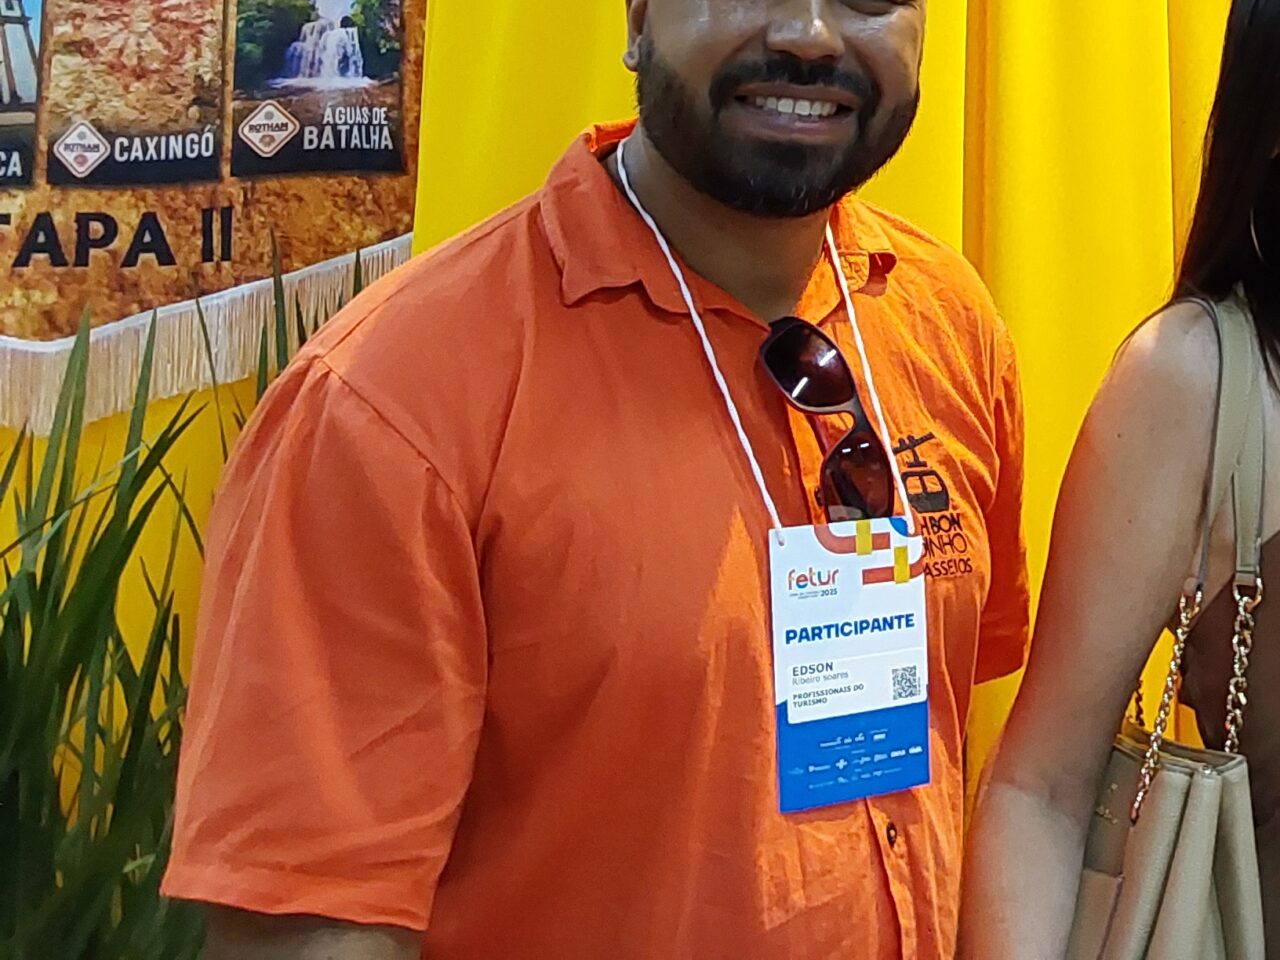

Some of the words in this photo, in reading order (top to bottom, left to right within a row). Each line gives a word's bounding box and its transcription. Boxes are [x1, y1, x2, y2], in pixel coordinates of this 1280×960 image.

[372, 107, 388, 125] DE
[114, 125, 214, 162] CAXINGÓ
[303, 125, 394, 150] BATALHA
[0, 211, 177, 268] APA
[788, 567, 839, 590] fetur
[785, 613, 915, 645] PARTICIPANTE
[792, 662, 833, 677] EDSON
[792, 685, 852, 700] PROFISSIONAIS
[853, 683, 864, 691] DO
[792, 697, 828, 708] TURISMO
